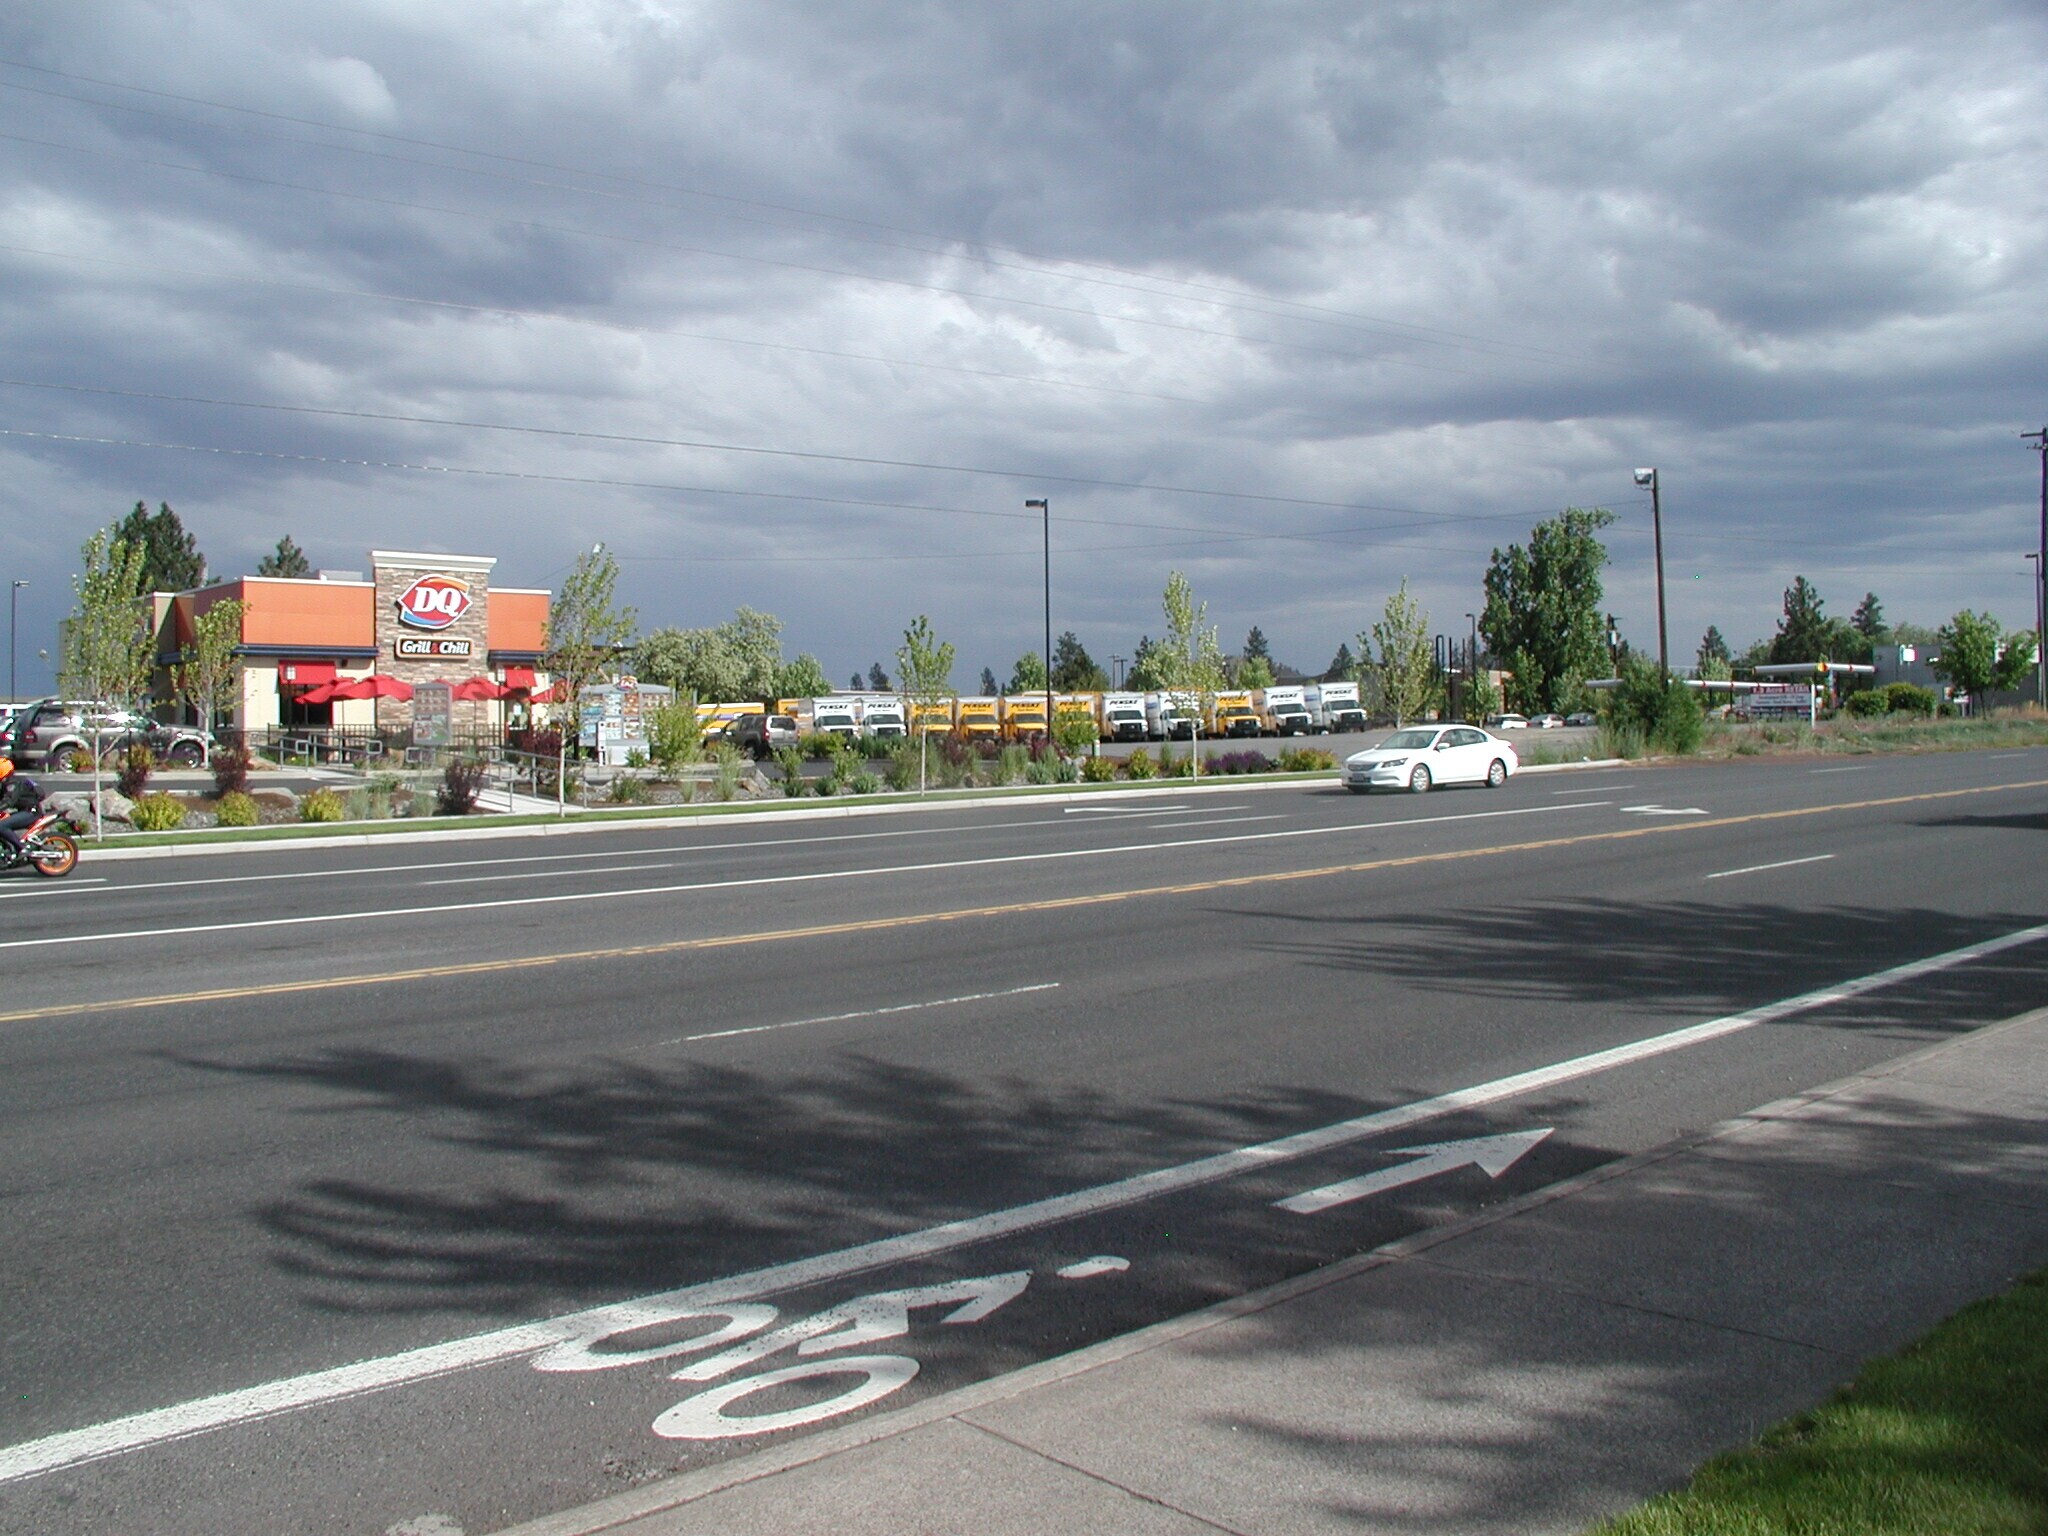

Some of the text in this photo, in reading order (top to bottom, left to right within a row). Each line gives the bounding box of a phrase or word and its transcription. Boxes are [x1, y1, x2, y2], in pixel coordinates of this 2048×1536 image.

[412, 586, 462, 617] DQ
[402, 640, 431, 653] Grill
[439, 642, 470, 655] Chill
